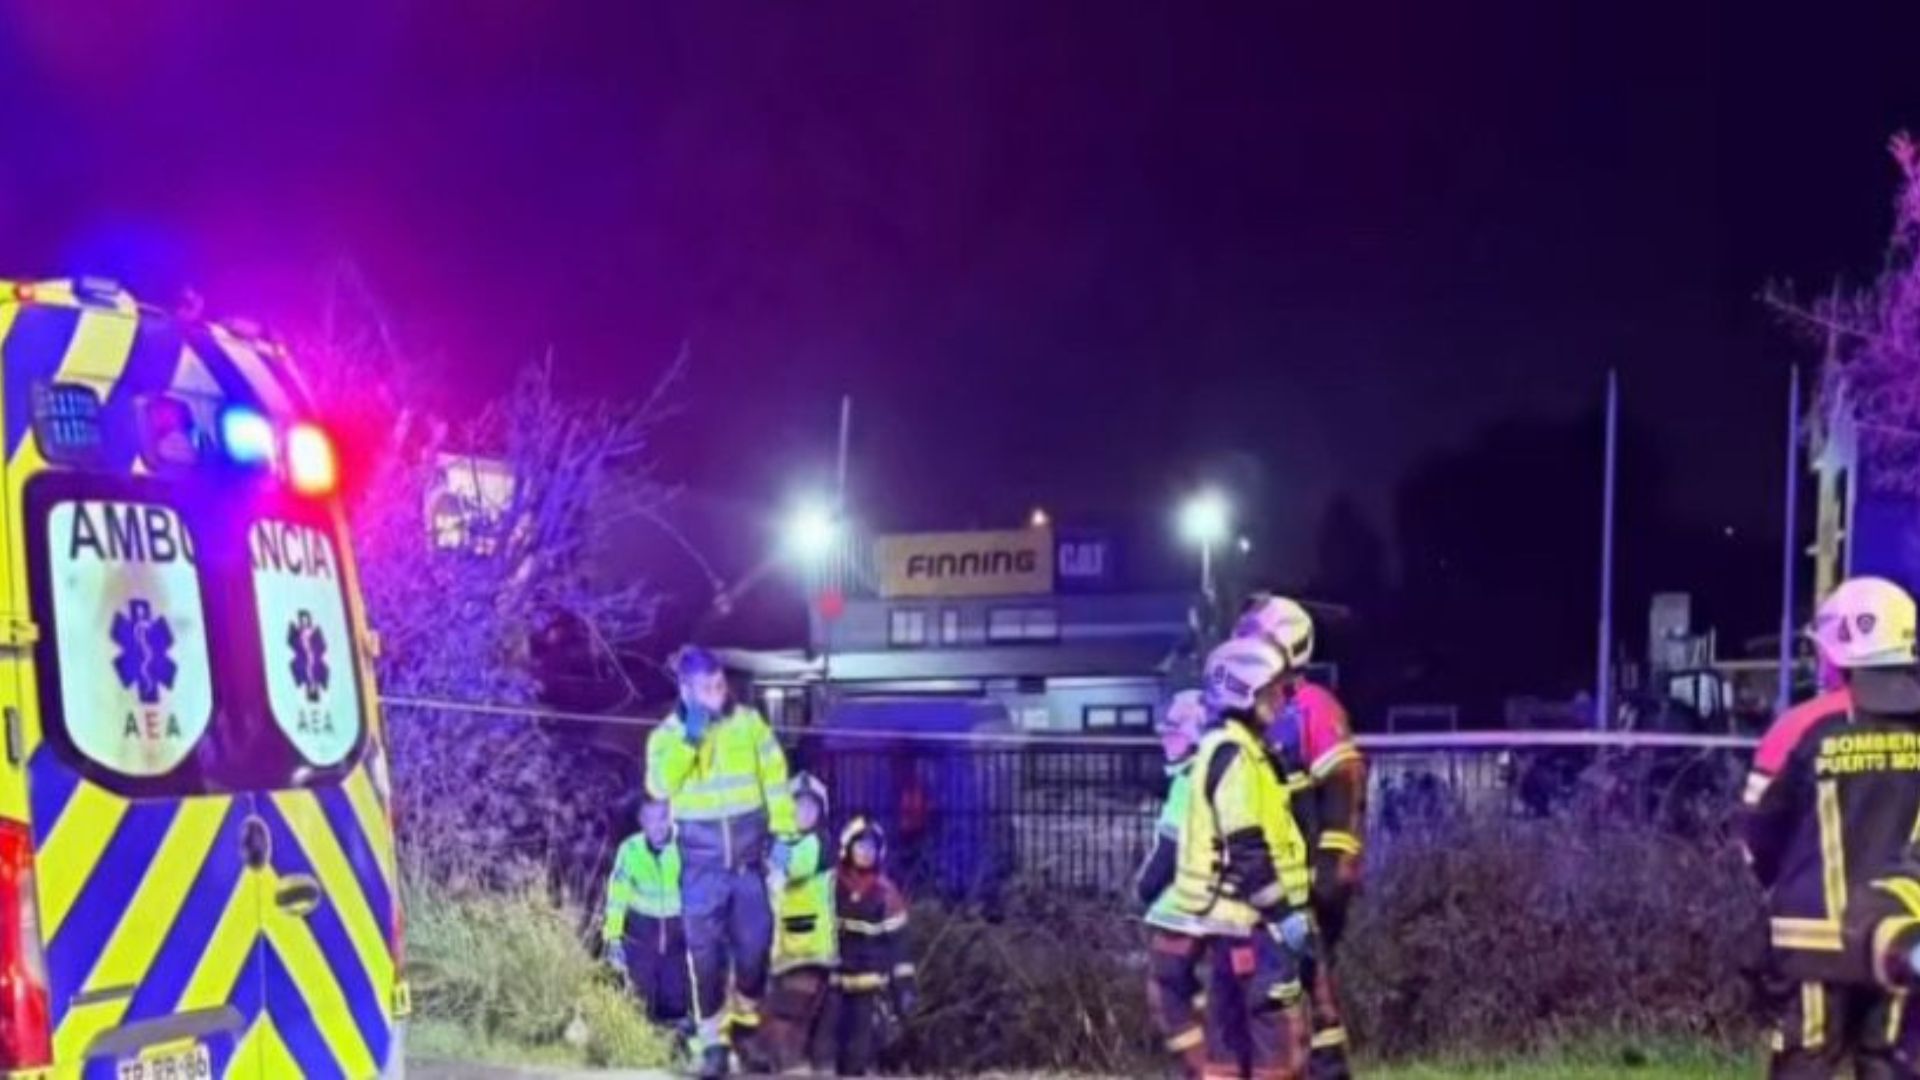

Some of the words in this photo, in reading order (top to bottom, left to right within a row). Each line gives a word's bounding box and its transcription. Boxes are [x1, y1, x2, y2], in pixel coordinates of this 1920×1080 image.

[252, 521, 332, 579] NCIA
[906, 550, 1037, 579] FINNING
[124, 710, 181, 739] AEA
[297, 708, 334, 733] AEA
[1822, 733, 1920, 754] BOMBER
[1891, 752, 1920, 771] MO
